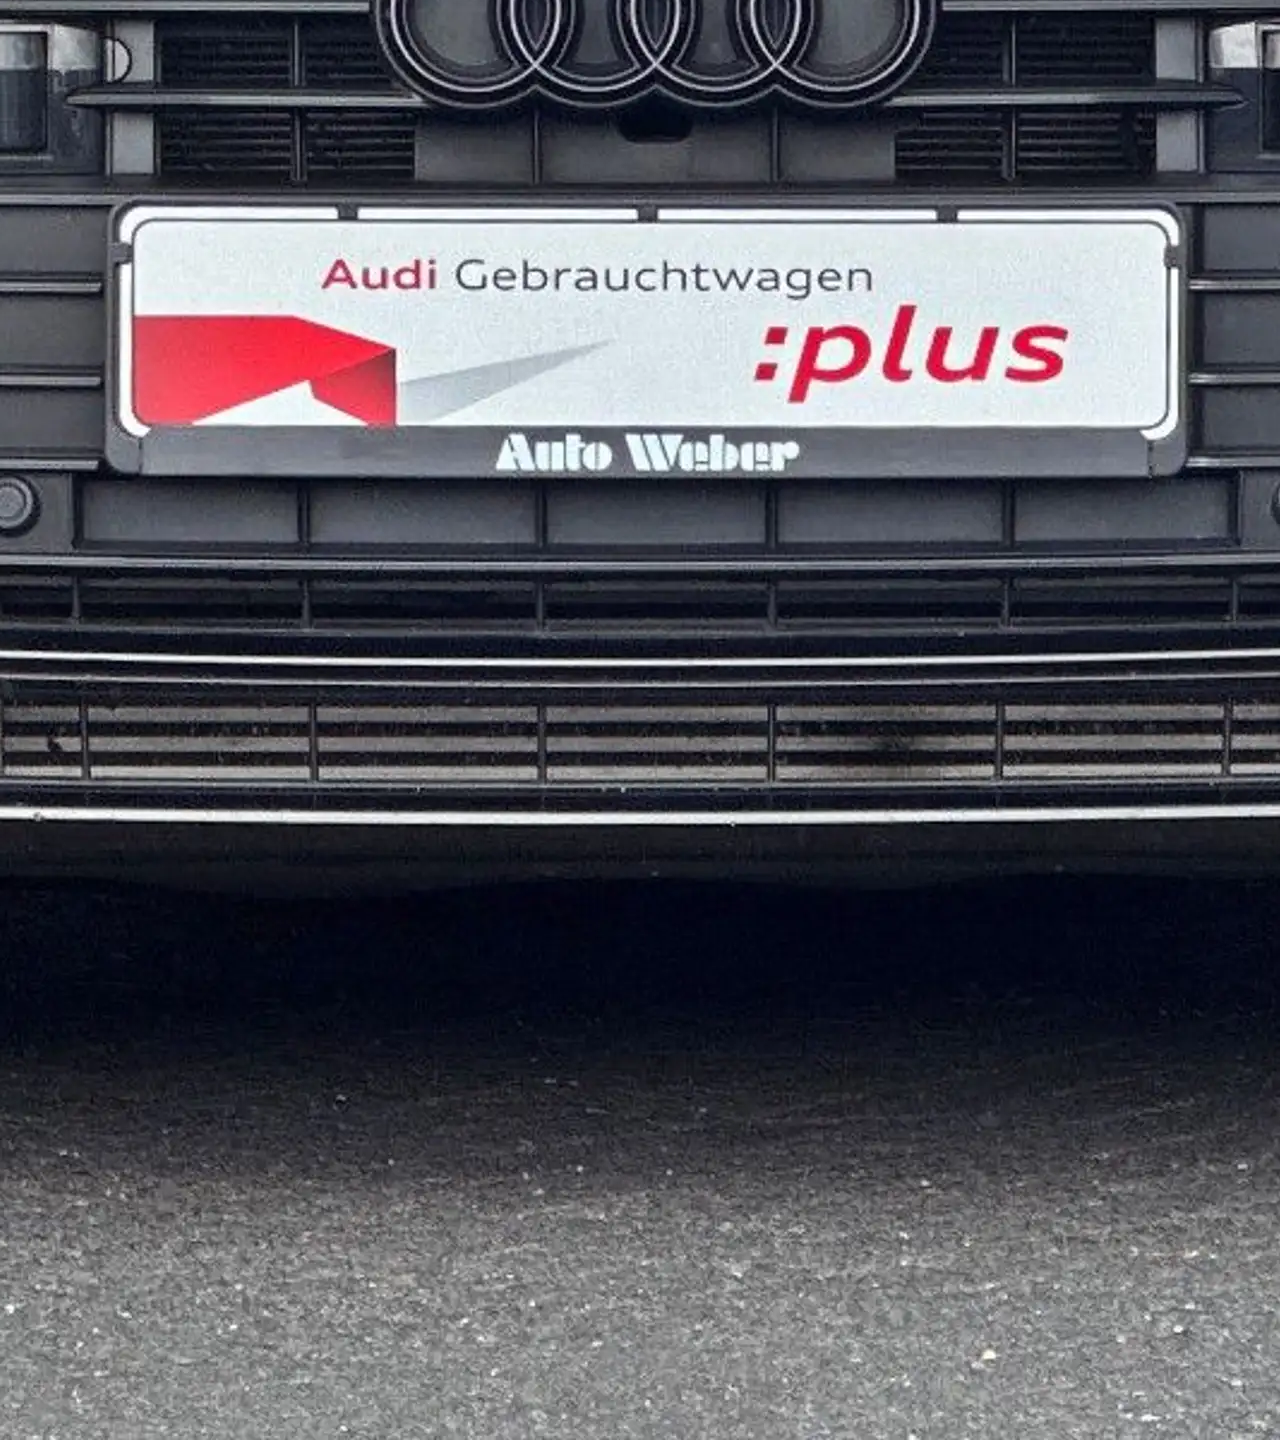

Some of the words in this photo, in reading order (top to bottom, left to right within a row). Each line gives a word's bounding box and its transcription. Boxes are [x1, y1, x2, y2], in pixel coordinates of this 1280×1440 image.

[322, 258, 437, 291] Audi
[454, 258, 873, 299] Gebrauchtwagen
[755, 304, 1068, 403] :plus
[494, 433, 612, 473] Auto
[625, 433, 800, 474] Weber
